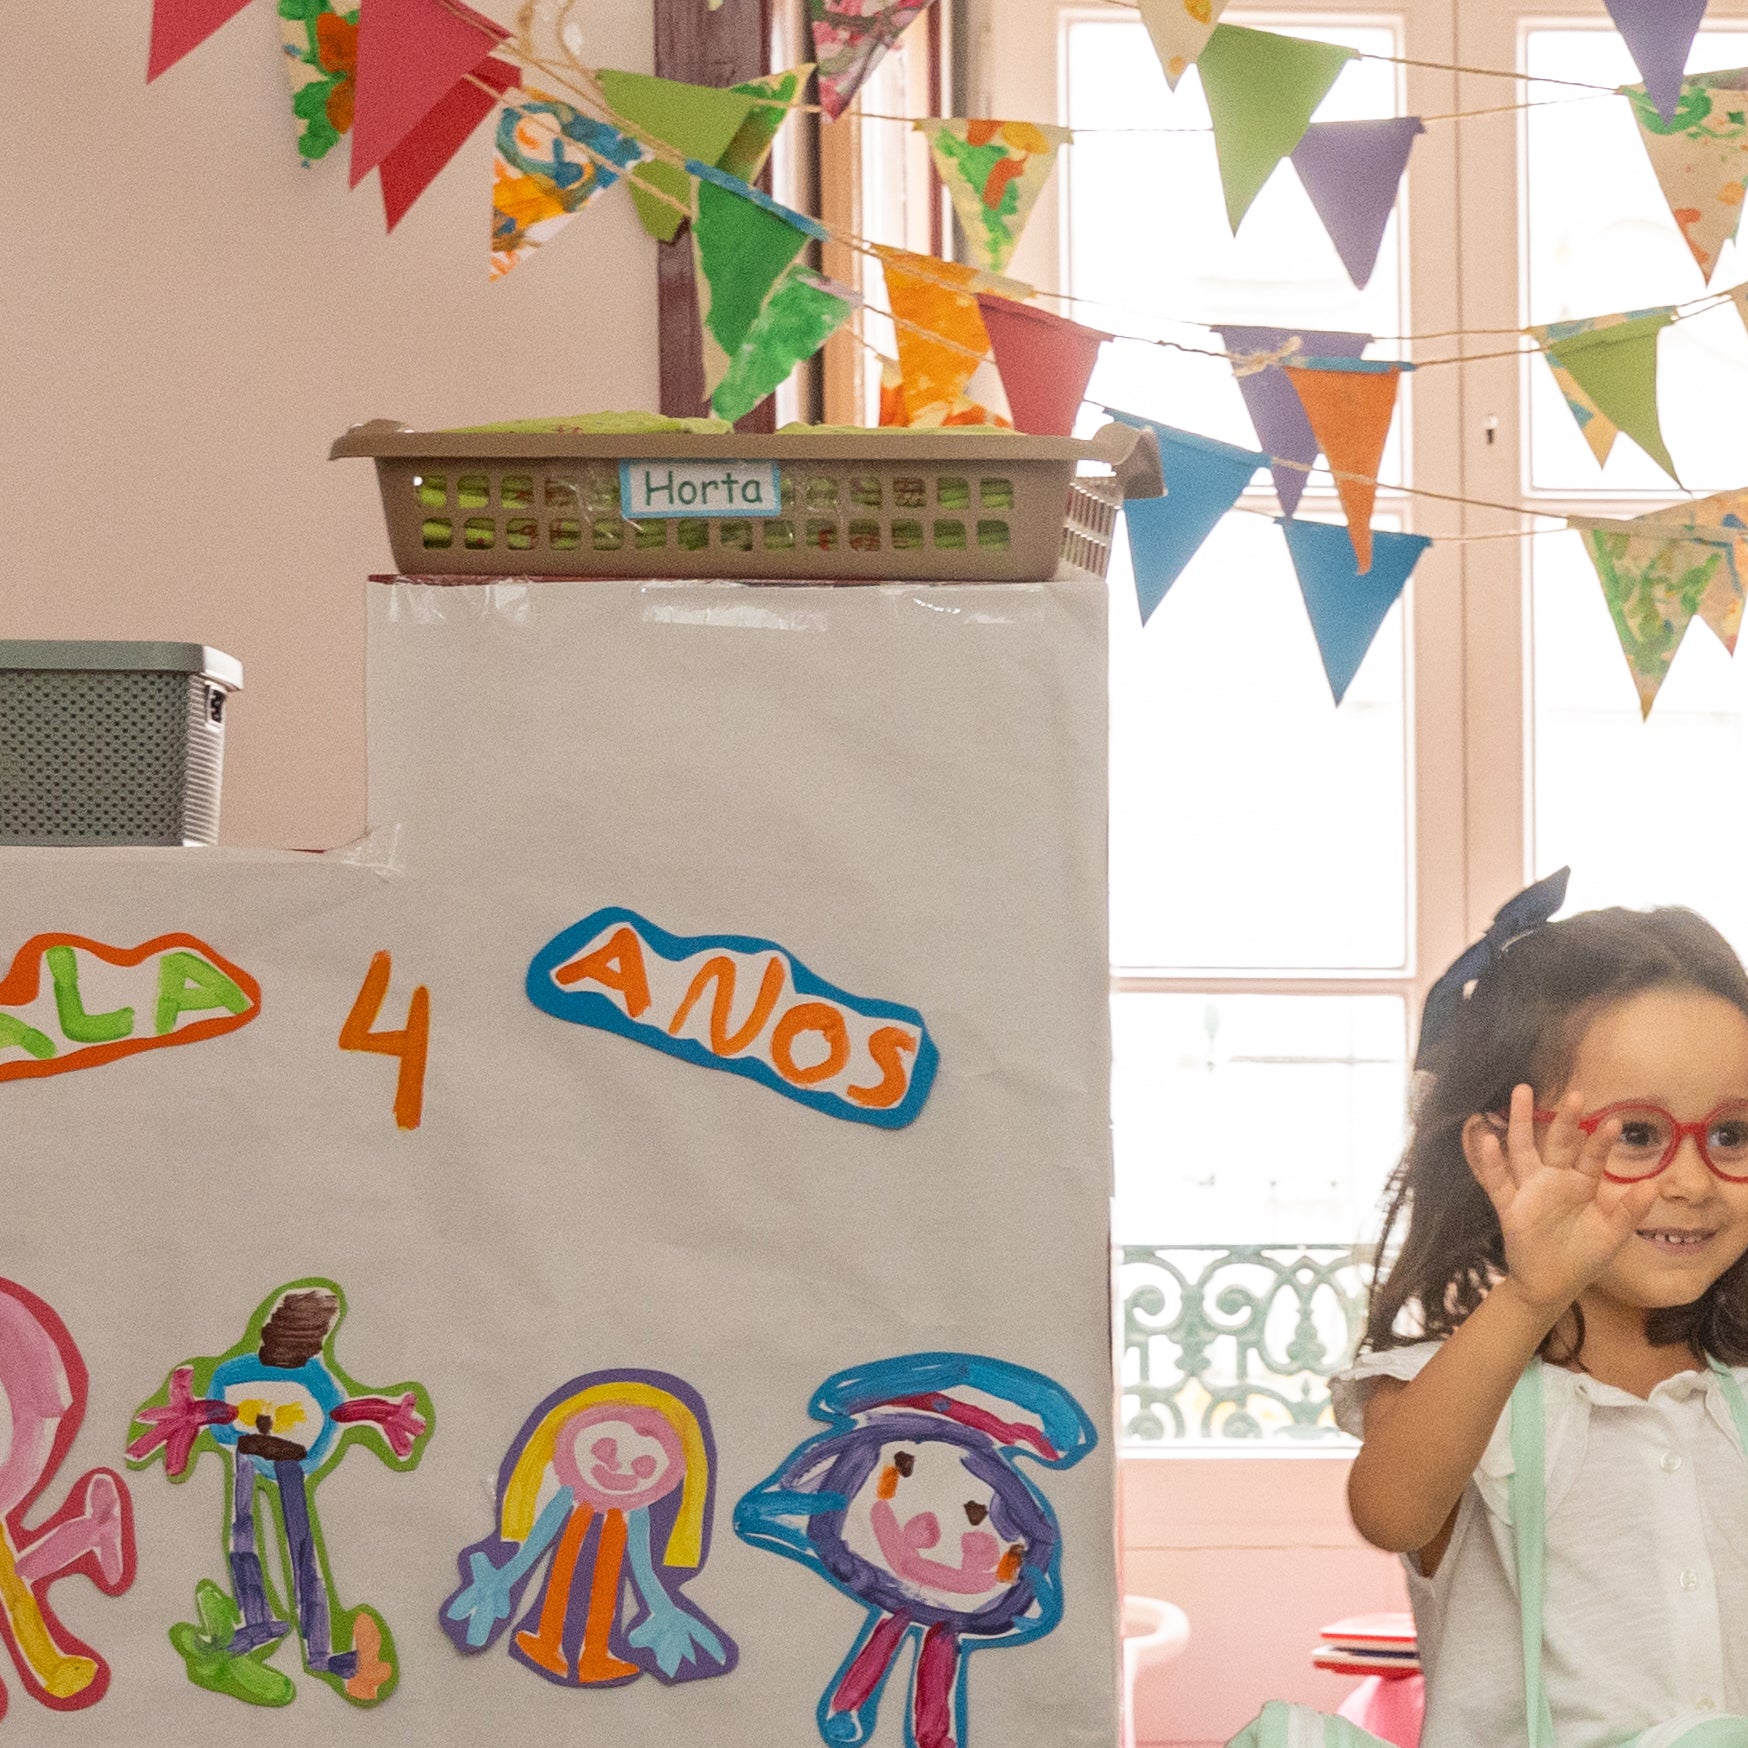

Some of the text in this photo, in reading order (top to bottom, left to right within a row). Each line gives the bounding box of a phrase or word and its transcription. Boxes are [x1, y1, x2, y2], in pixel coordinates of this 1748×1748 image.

[644, 470, 764, 507] Horta
[337, 949, 432, 1132] 4
[554, 926, 918, 1108] ANOS
